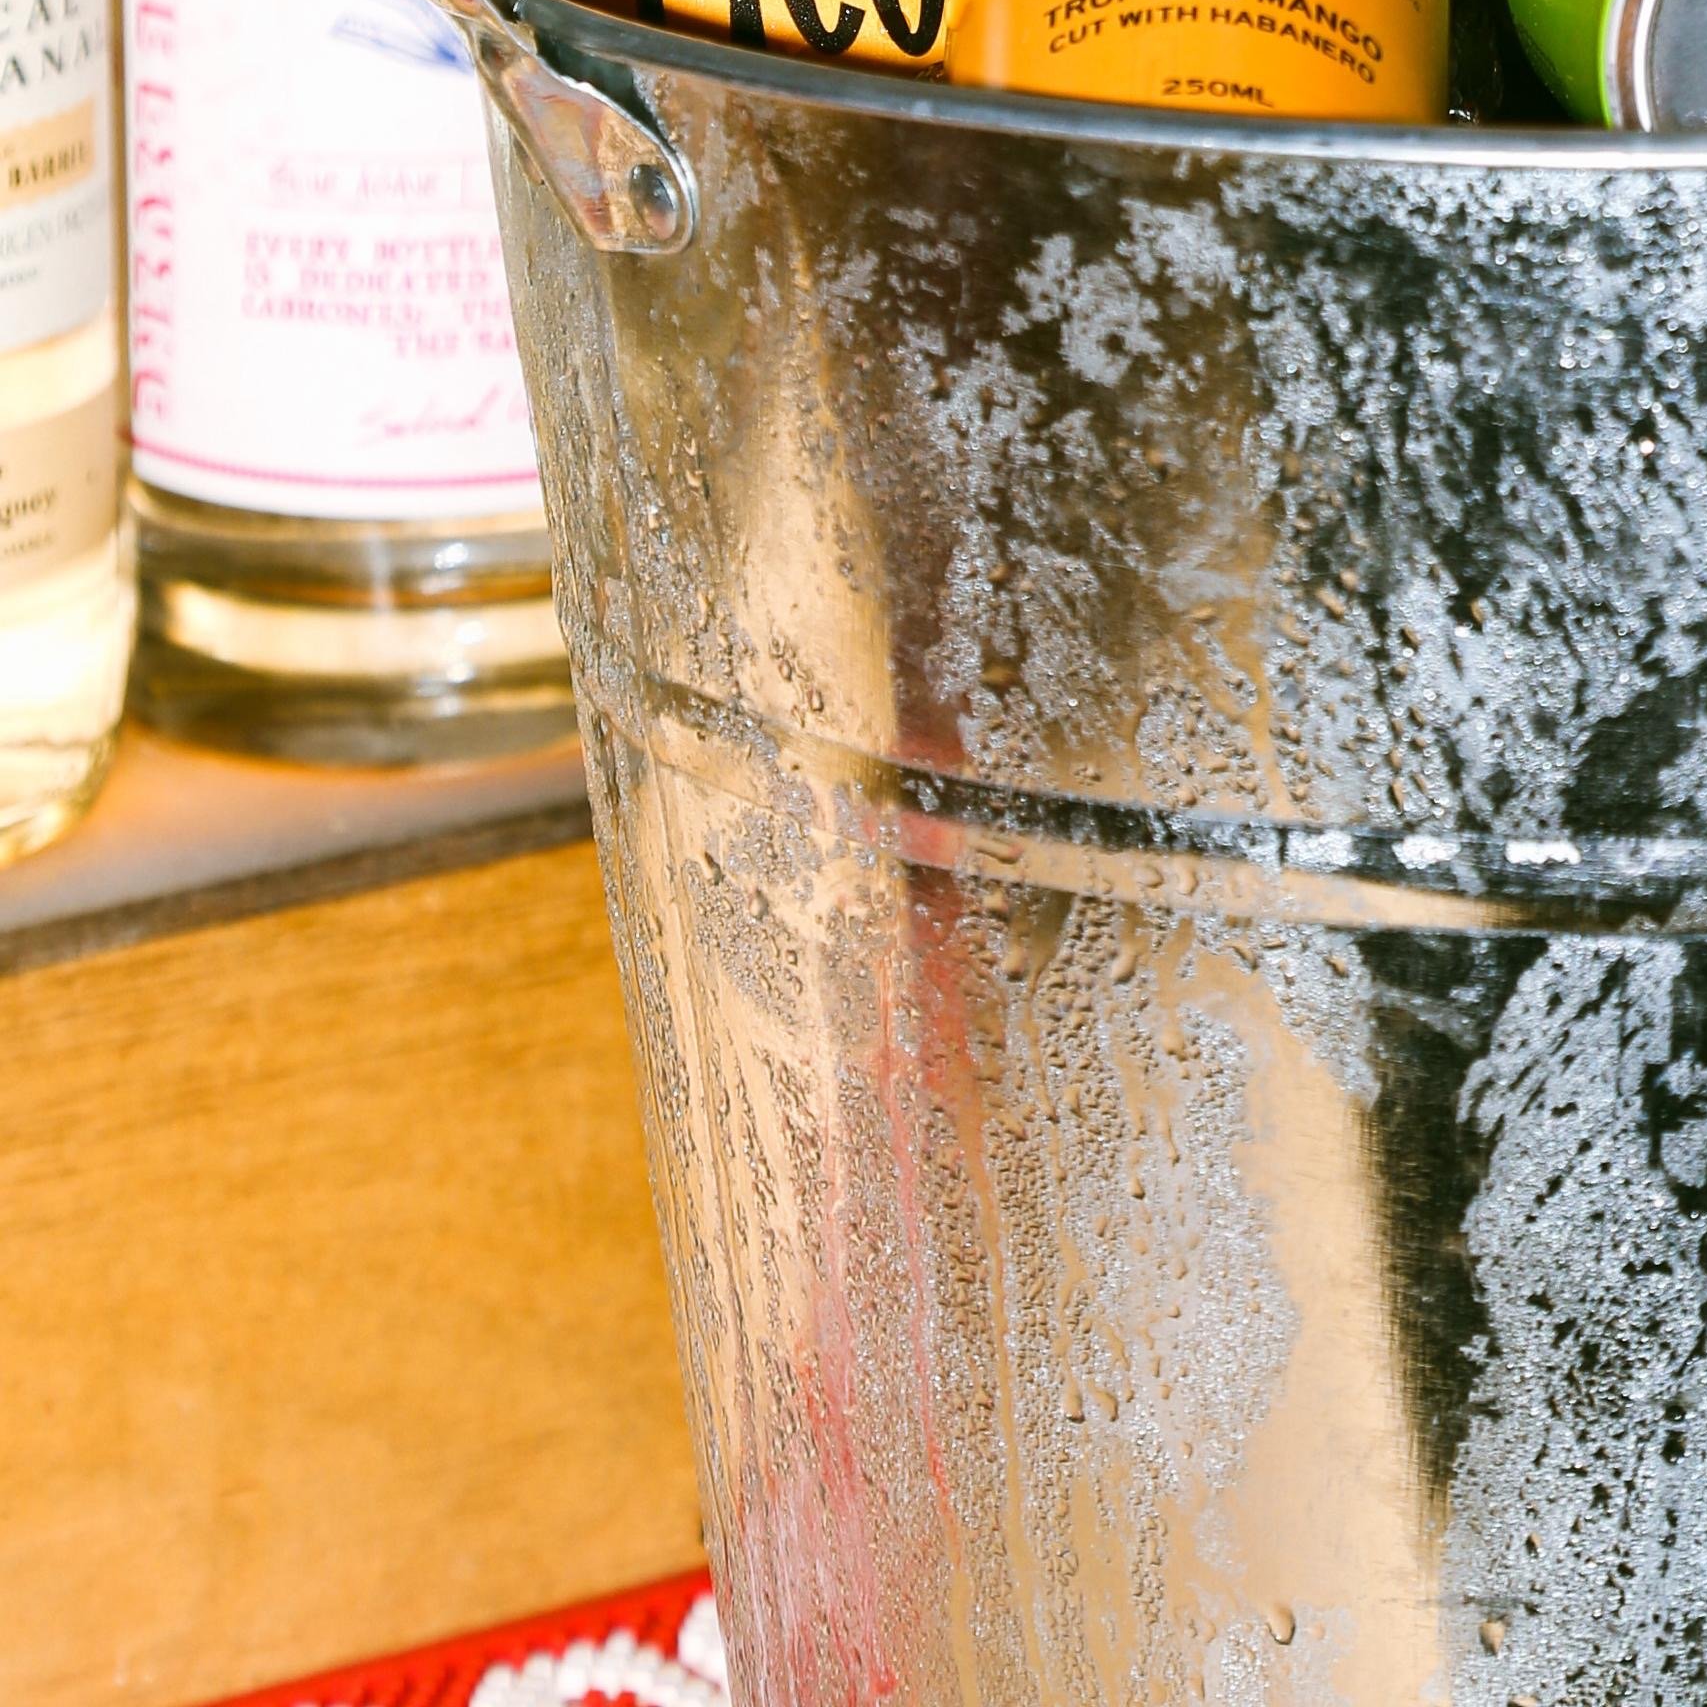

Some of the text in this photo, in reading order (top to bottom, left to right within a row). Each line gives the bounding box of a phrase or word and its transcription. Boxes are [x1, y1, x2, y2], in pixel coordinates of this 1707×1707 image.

[1049, 4, 1377, 86] CUT WITH HABANERO
[1162, 78, 1276, 109] 250ML
